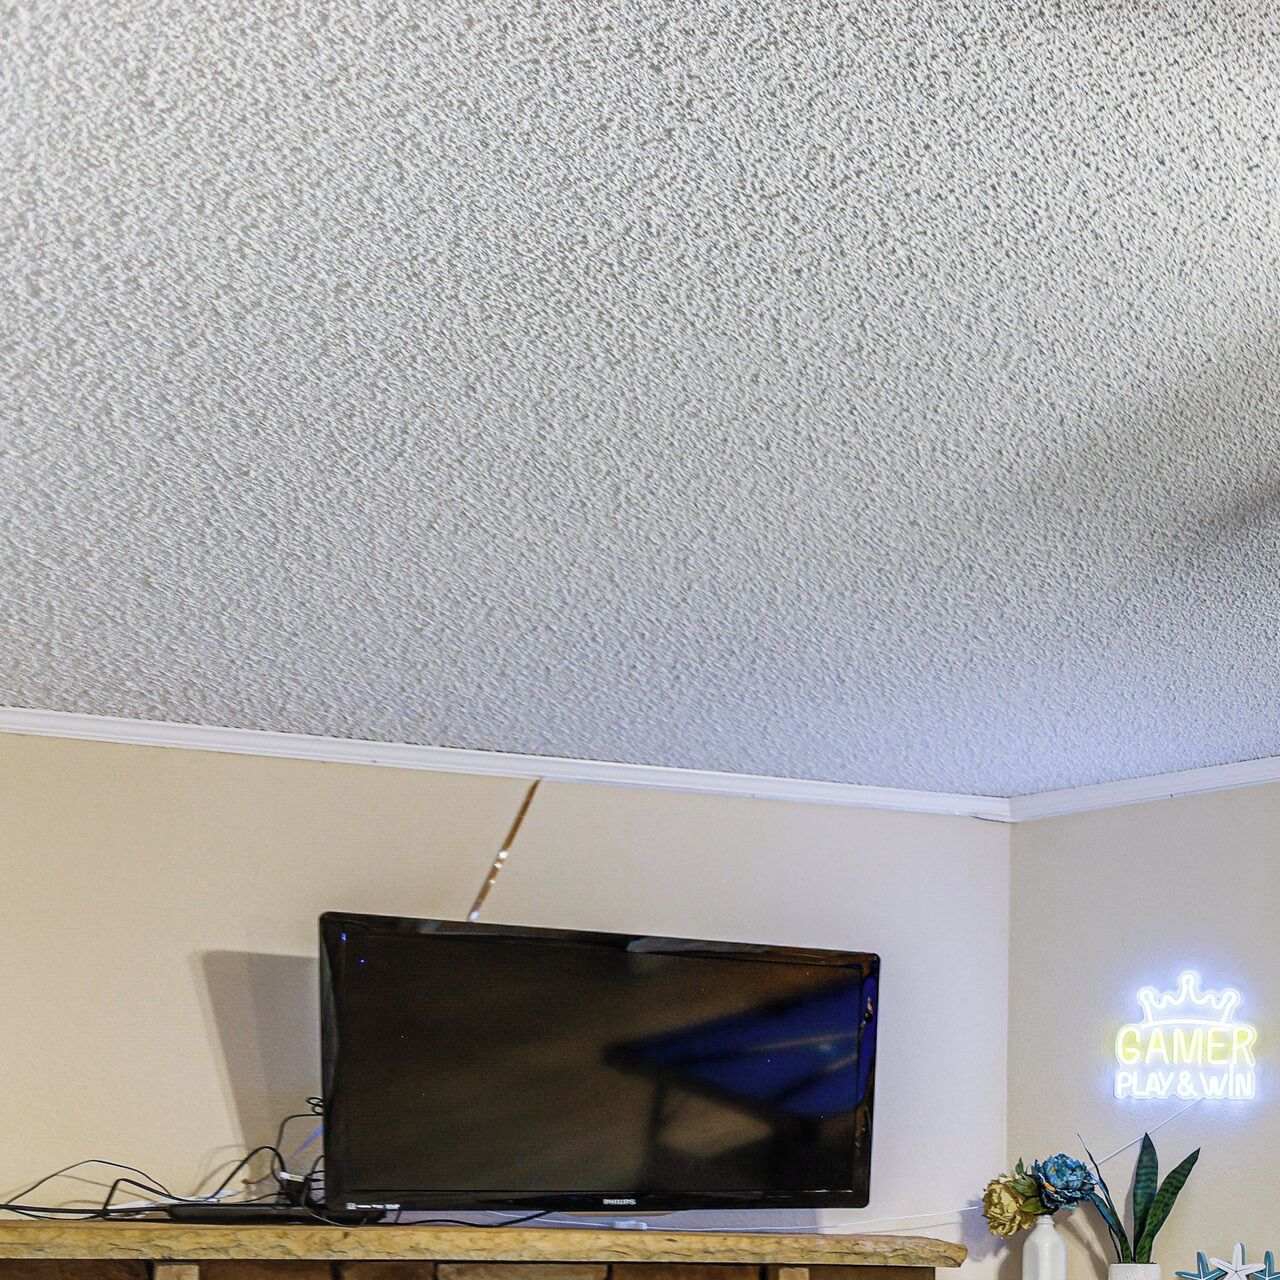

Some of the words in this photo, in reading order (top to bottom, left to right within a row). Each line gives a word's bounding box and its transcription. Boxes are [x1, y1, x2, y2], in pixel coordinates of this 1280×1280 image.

[1115, 1026, 1257, 1067] GAMER
[1116, 1072, 1175, 1097] PLAY
[1177, 1071, 1199, 1097] &
[1200, 1065, 1253, 1097] WIN
